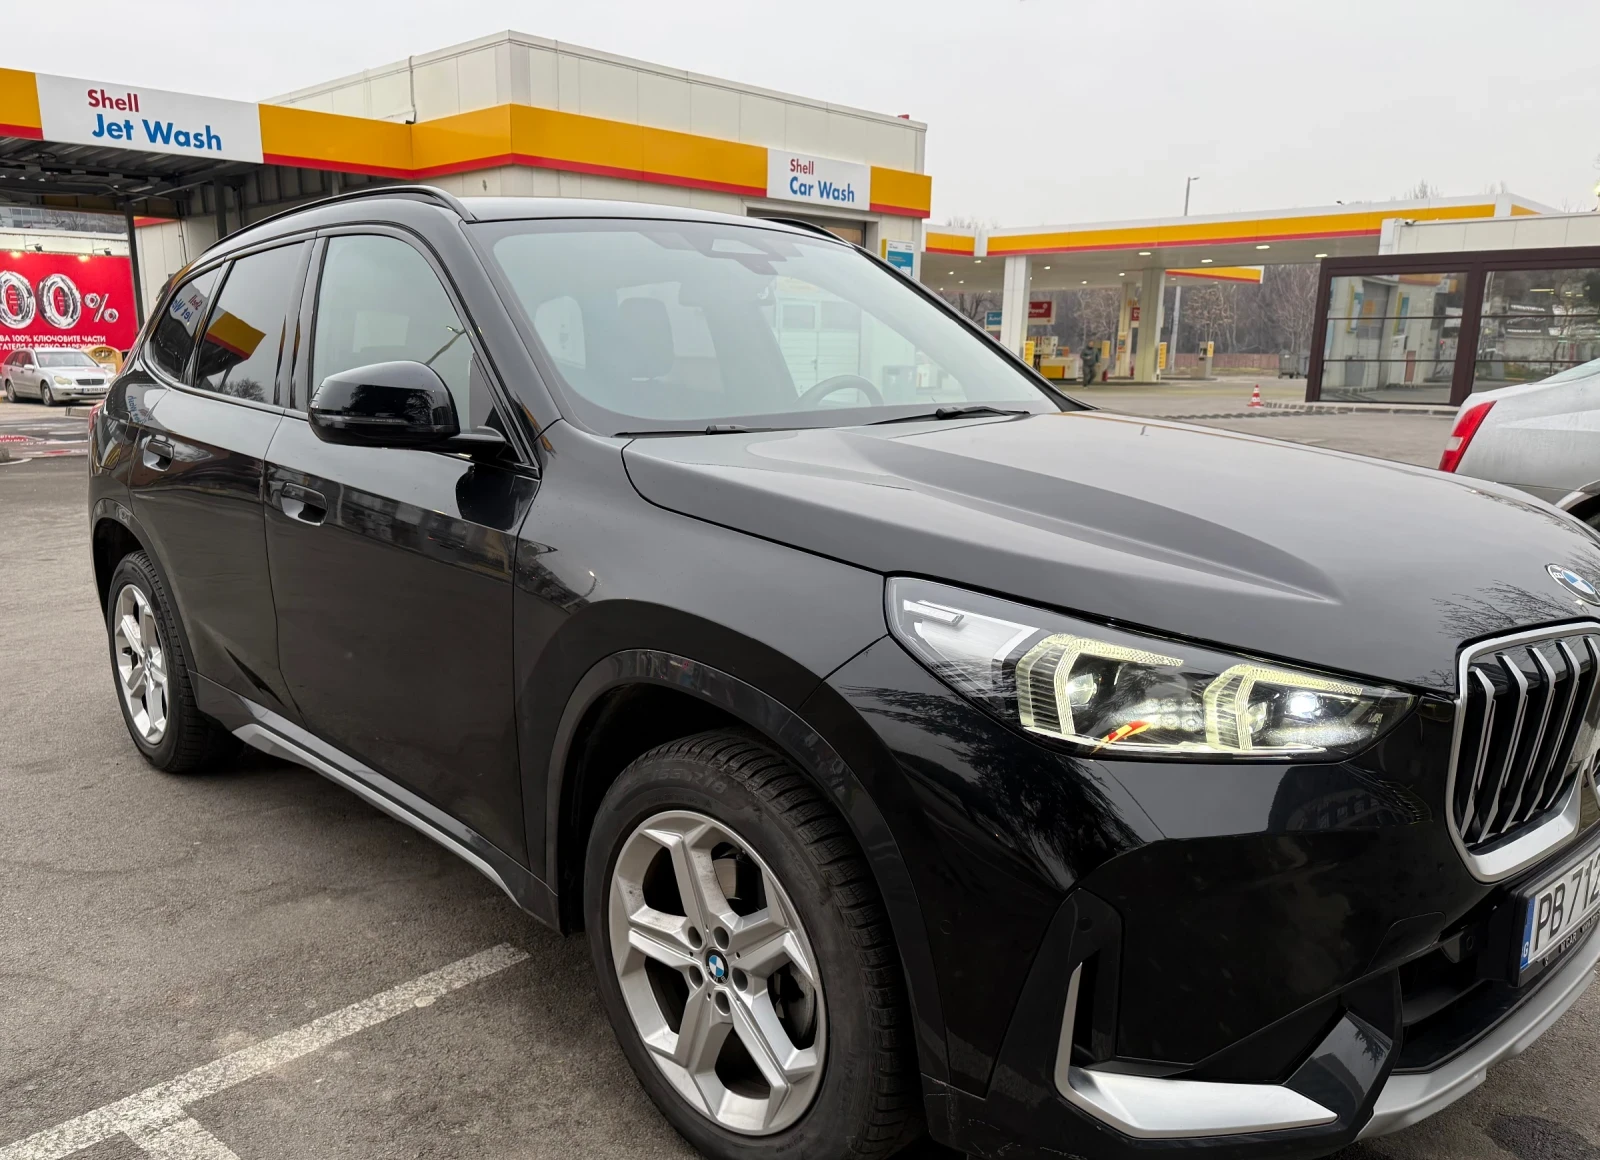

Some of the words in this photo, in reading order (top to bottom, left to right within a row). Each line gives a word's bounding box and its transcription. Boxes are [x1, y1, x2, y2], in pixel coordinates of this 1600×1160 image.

[87, 88, 140, 112] Shell
[92, 113, 134, 141] Jet
[142, 119, 222, 151] Wash
[790, 158, 814, 175] Shell
[789, 176, 814, 196] Car
[818, 180, 855, 203] Wash
[33, 335, 81, 343] КЛЮЧОВИТЕ
[82, 335, 106, 343] ЧАСТИ
[1534, 883, 1565, 952] PB
